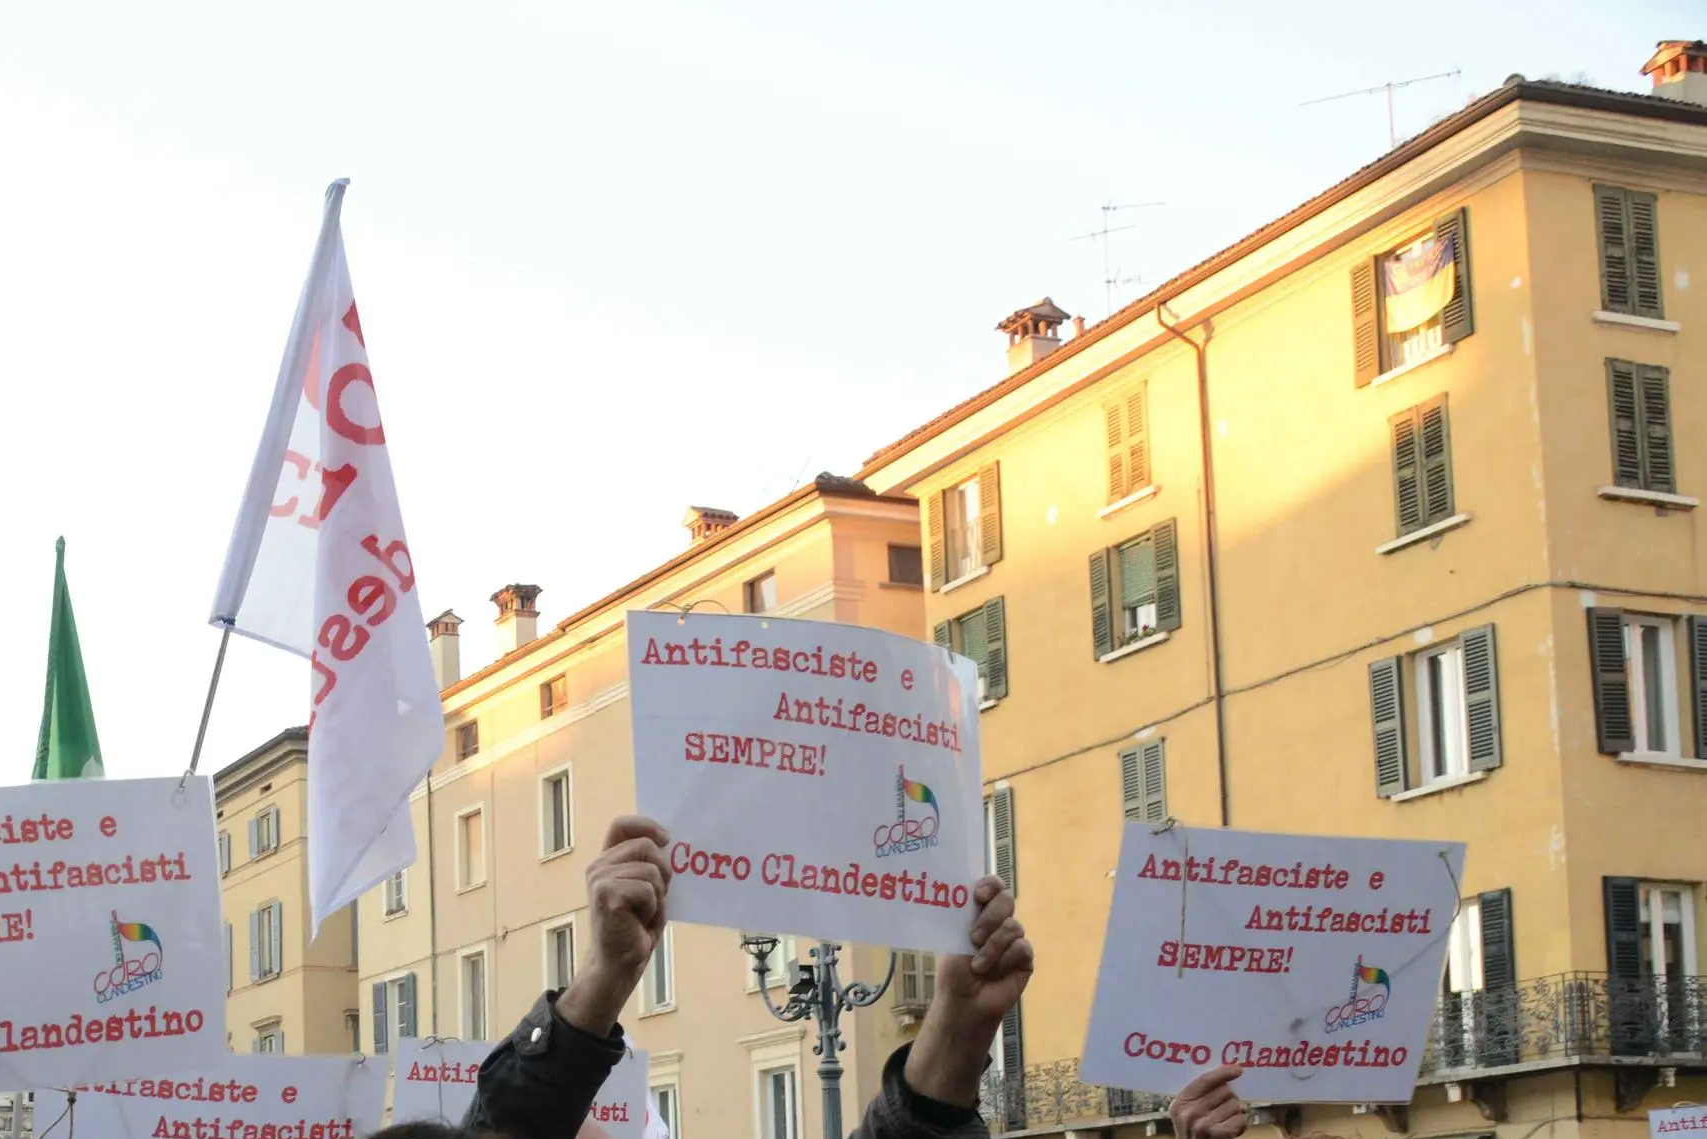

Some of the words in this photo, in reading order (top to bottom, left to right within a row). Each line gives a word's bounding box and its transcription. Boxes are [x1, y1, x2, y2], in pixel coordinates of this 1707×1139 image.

[641, 639, 878, 683] Antifasciste
[901, 669, 913, 690] e
[774, 692, 960, 752] Antifascisti
[685, 733, 826, 775] SEMPRE!
[101, 816, 117, 836] e
[670, 842, 751, 880] Coro
[762, 855, 969, 908] Clandestino
[1138, 854, 1349, 889] Antifasciste
[1369, 872, 1384, 889] e
[1245, 906, 1429, 934] Antifascisti
[1158, 942, 1295, 974] SEMPRE!
[1124, 1032, 1211, 1066] Coro
[1222, 1040, 1407, 1068] Clandestino
[282, 1088, 297, 1104] e
